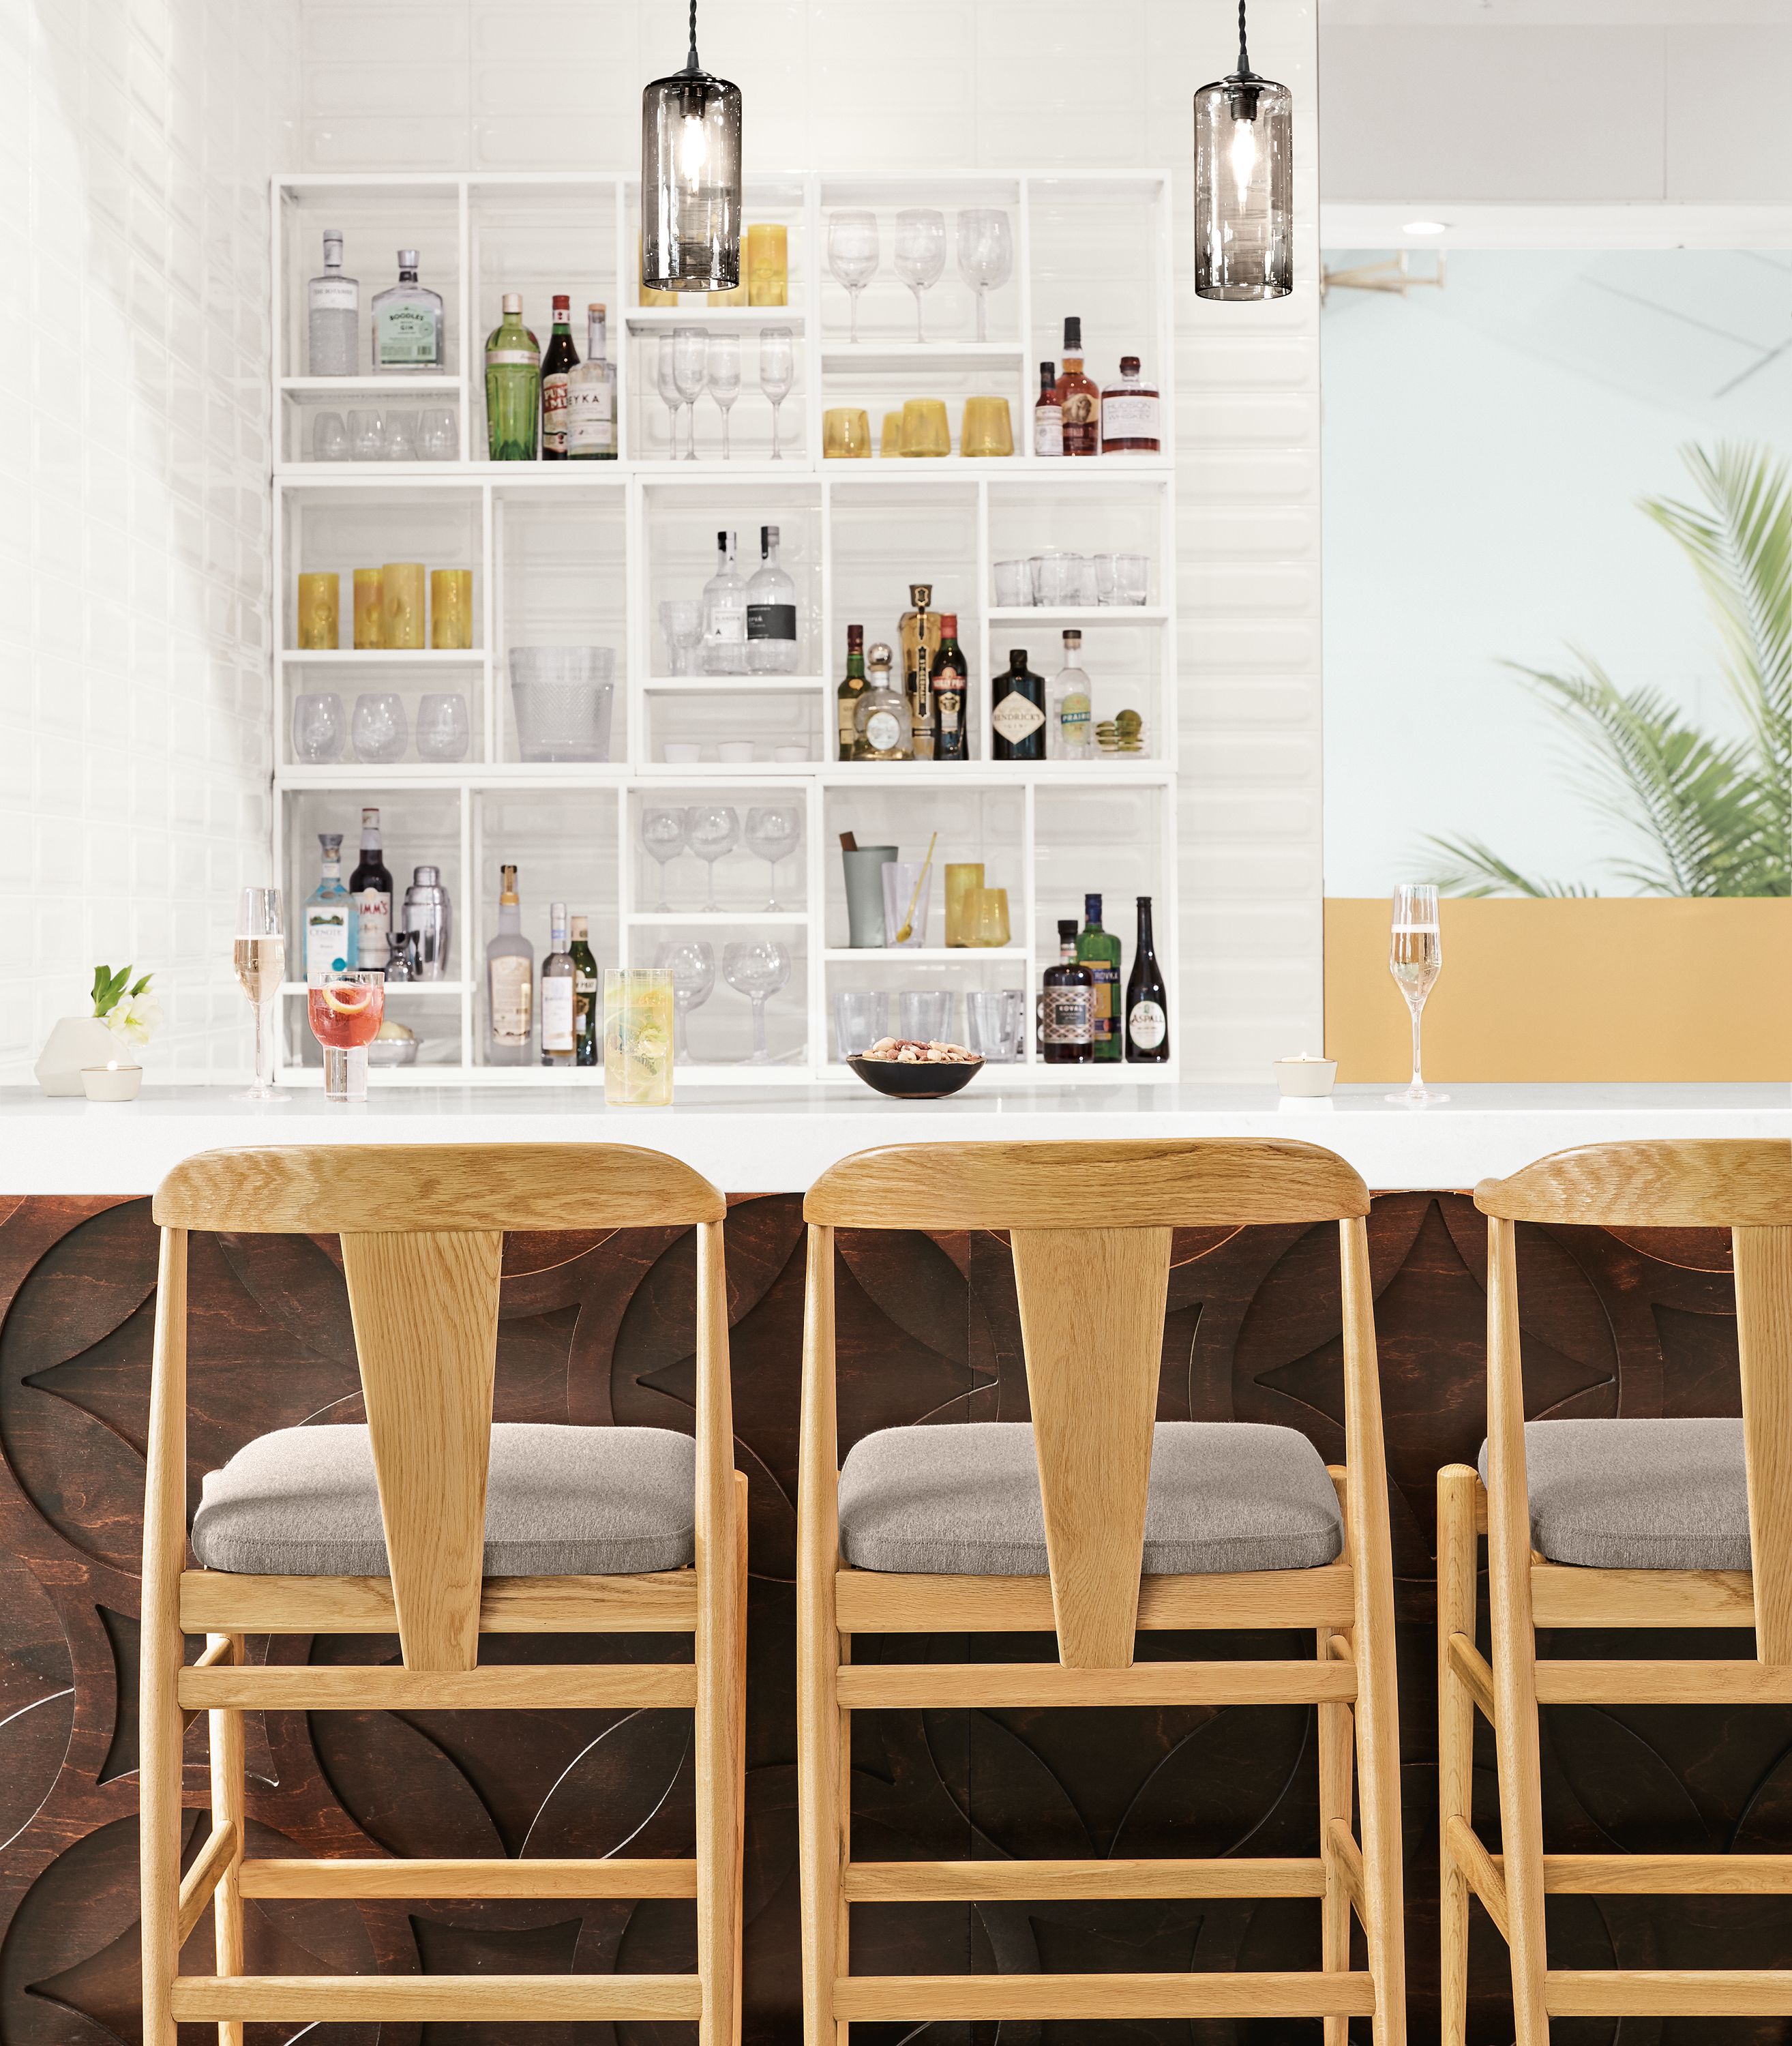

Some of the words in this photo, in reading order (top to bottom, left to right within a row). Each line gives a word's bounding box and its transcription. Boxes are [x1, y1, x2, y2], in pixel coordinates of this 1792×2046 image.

[567, 395, 599, 406] EYKA
[360, 901, 388, 915] IMM'S
[1130, 1014, 1164, 1025] ASPALL
